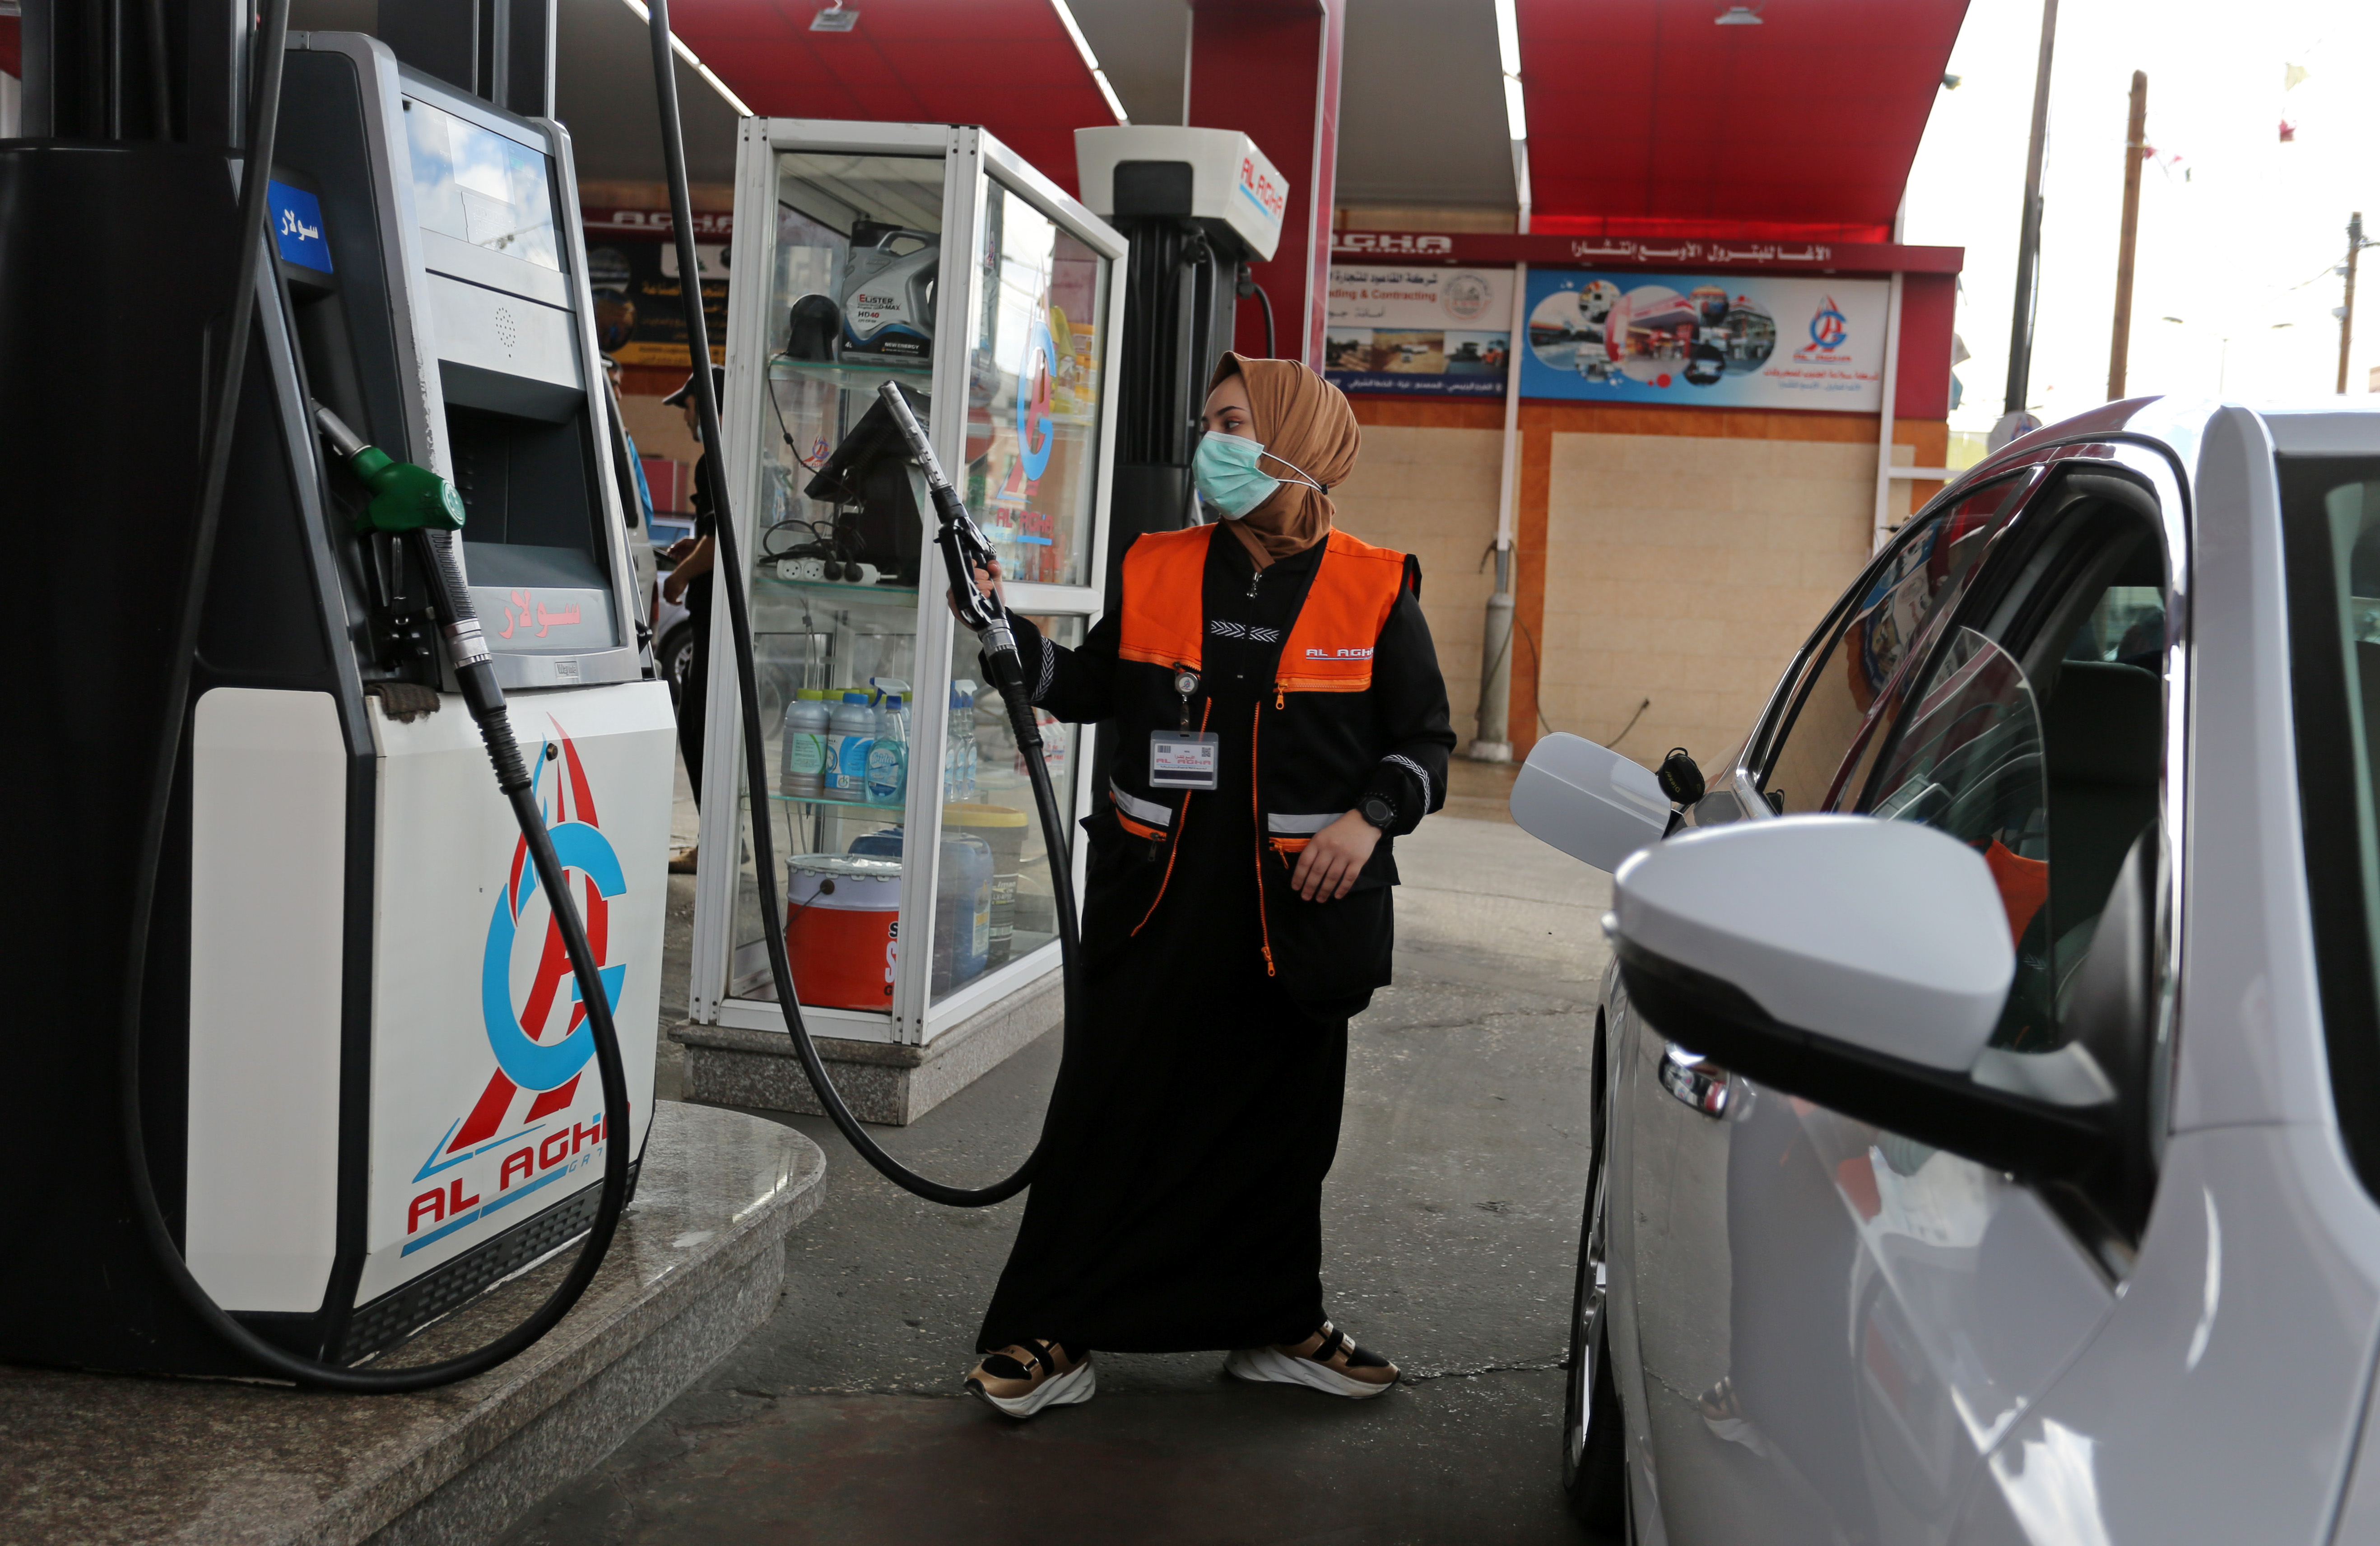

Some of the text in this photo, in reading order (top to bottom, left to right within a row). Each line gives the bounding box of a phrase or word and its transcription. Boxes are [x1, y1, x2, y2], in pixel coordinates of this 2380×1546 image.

[1241, 157, 1254, 190] AL
[281, 209, 319, 241] سولار
[1360, 289, 1368, 298] &
[1371, 289, 1437, 303] Contracting
[996, 508, 1013, 528] AL
[498, 588, 581, 639] سولار
[556, 663, 576, 676] Wayne
[407, 1178, 480, 1235] AL
